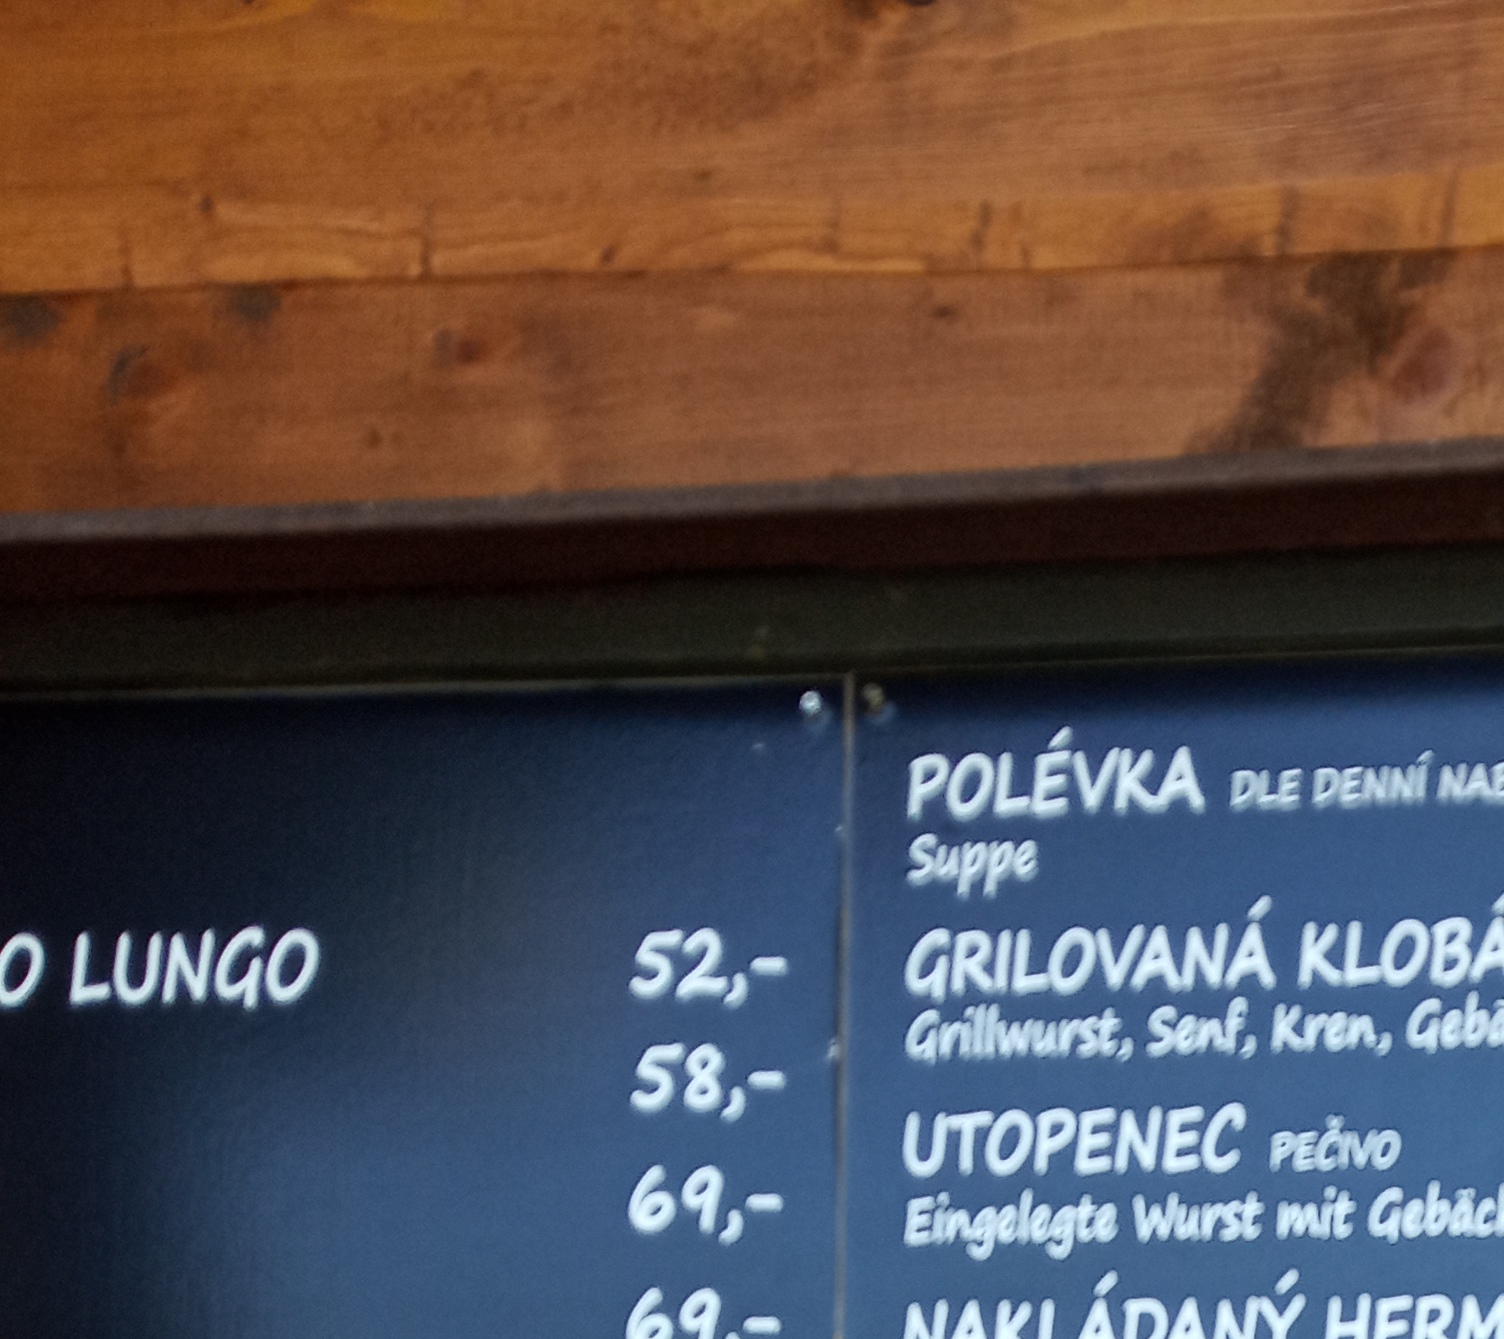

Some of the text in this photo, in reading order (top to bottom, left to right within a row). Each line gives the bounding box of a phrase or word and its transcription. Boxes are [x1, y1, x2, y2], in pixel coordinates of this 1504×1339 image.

[906, 726, 1206, 822] POLÉVKA
[1229, 767, 1304, 811] DLE
[1311, 749, 1434, 809] DENNÍ
[906, 832, 1038, 899] Suppe
[69, 925, 320, 1009] LUNGO
[629, 927, 788, 1008] 52,-
[904, 895, 1277, 1003] GRILOVANÁ
[904, 1004, 1134, 1065] Grillwurst,
[1146, 996, 1257, 1059] Senf,
[1270, 1003, 1393, 1056] Kren,
[630, 1042, 786, 1122] 58,-
[902, 1101, 1403, 1179] UTOPENEC PEČIVO
[627, 1164, 784, 1245] 69,-
[903, 1188, 1118, 1262] Eingelegte
[1132, 1191, 1265, 1243] Wurst
[1275, 1185, 1357, 1240] mit
